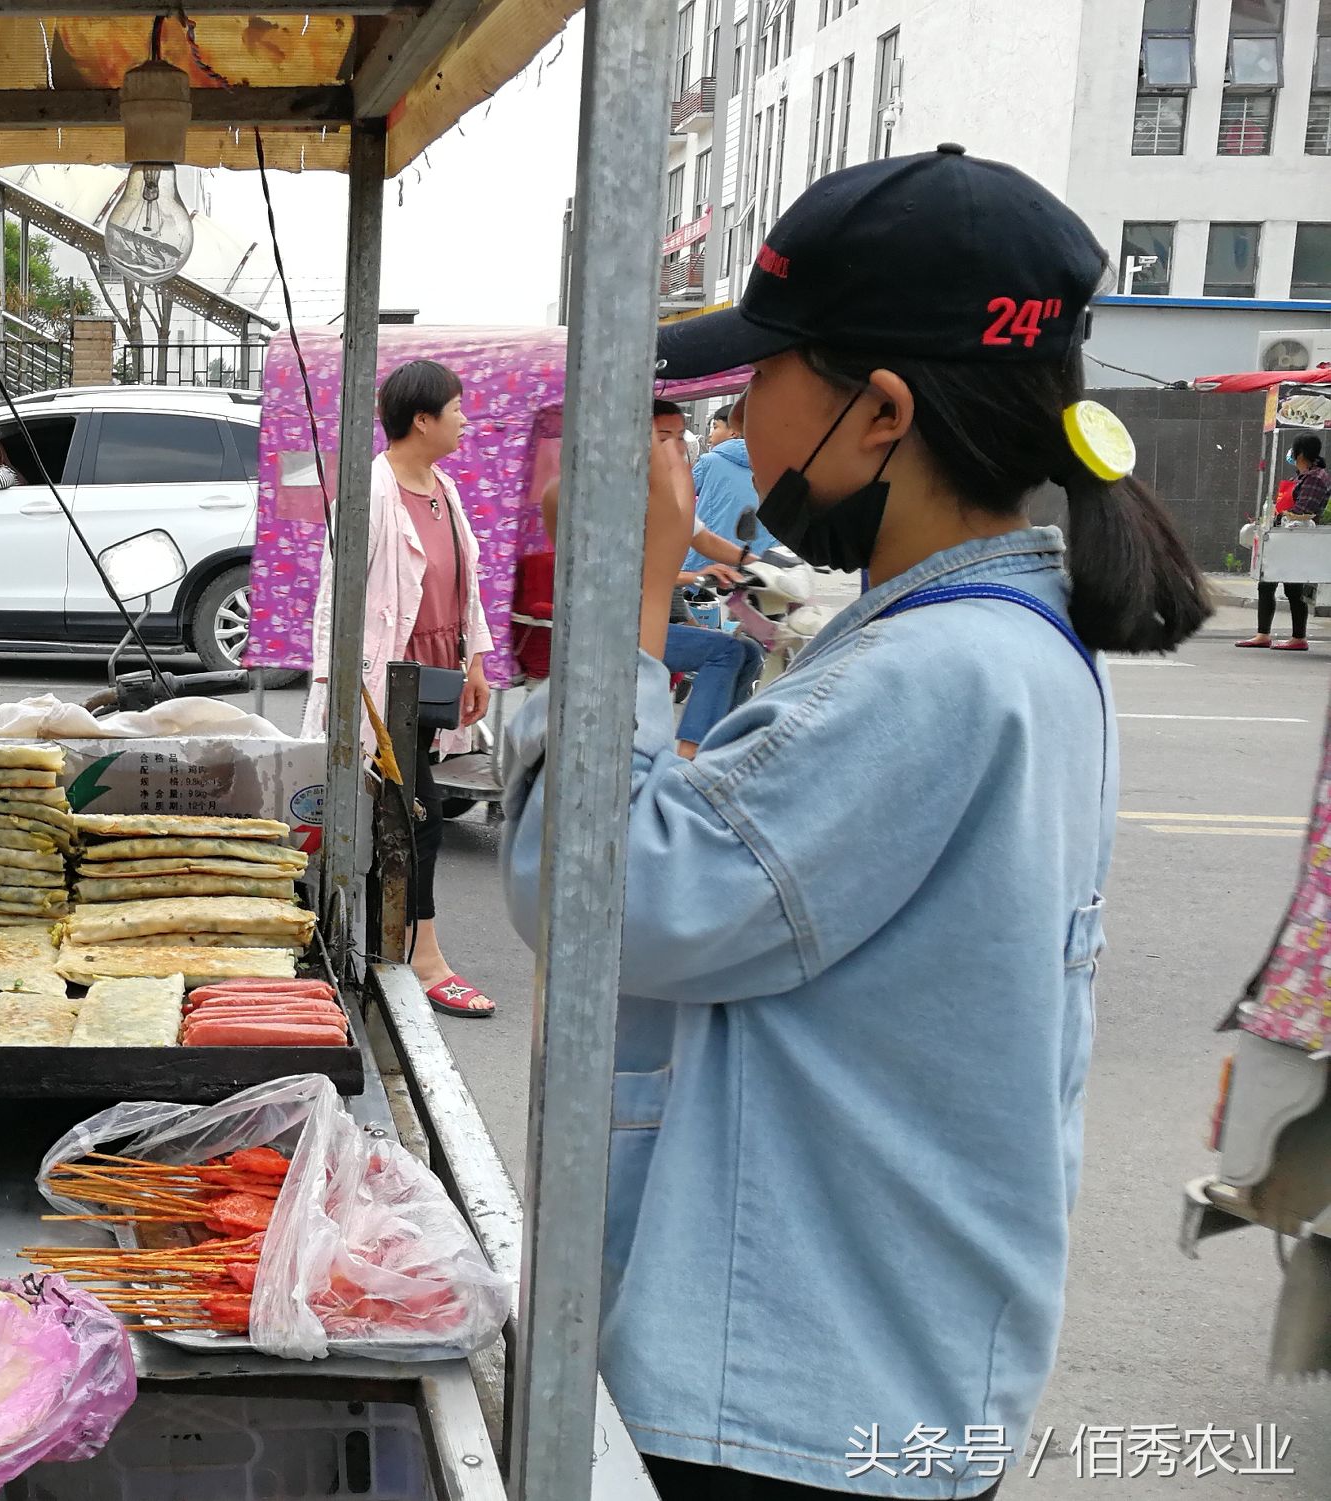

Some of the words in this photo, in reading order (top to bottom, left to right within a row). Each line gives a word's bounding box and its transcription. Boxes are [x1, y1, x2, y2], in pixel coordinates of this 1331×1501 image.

[982, 296, 1062, 347] 24"
[139, 753, 178, 763] 合格品
